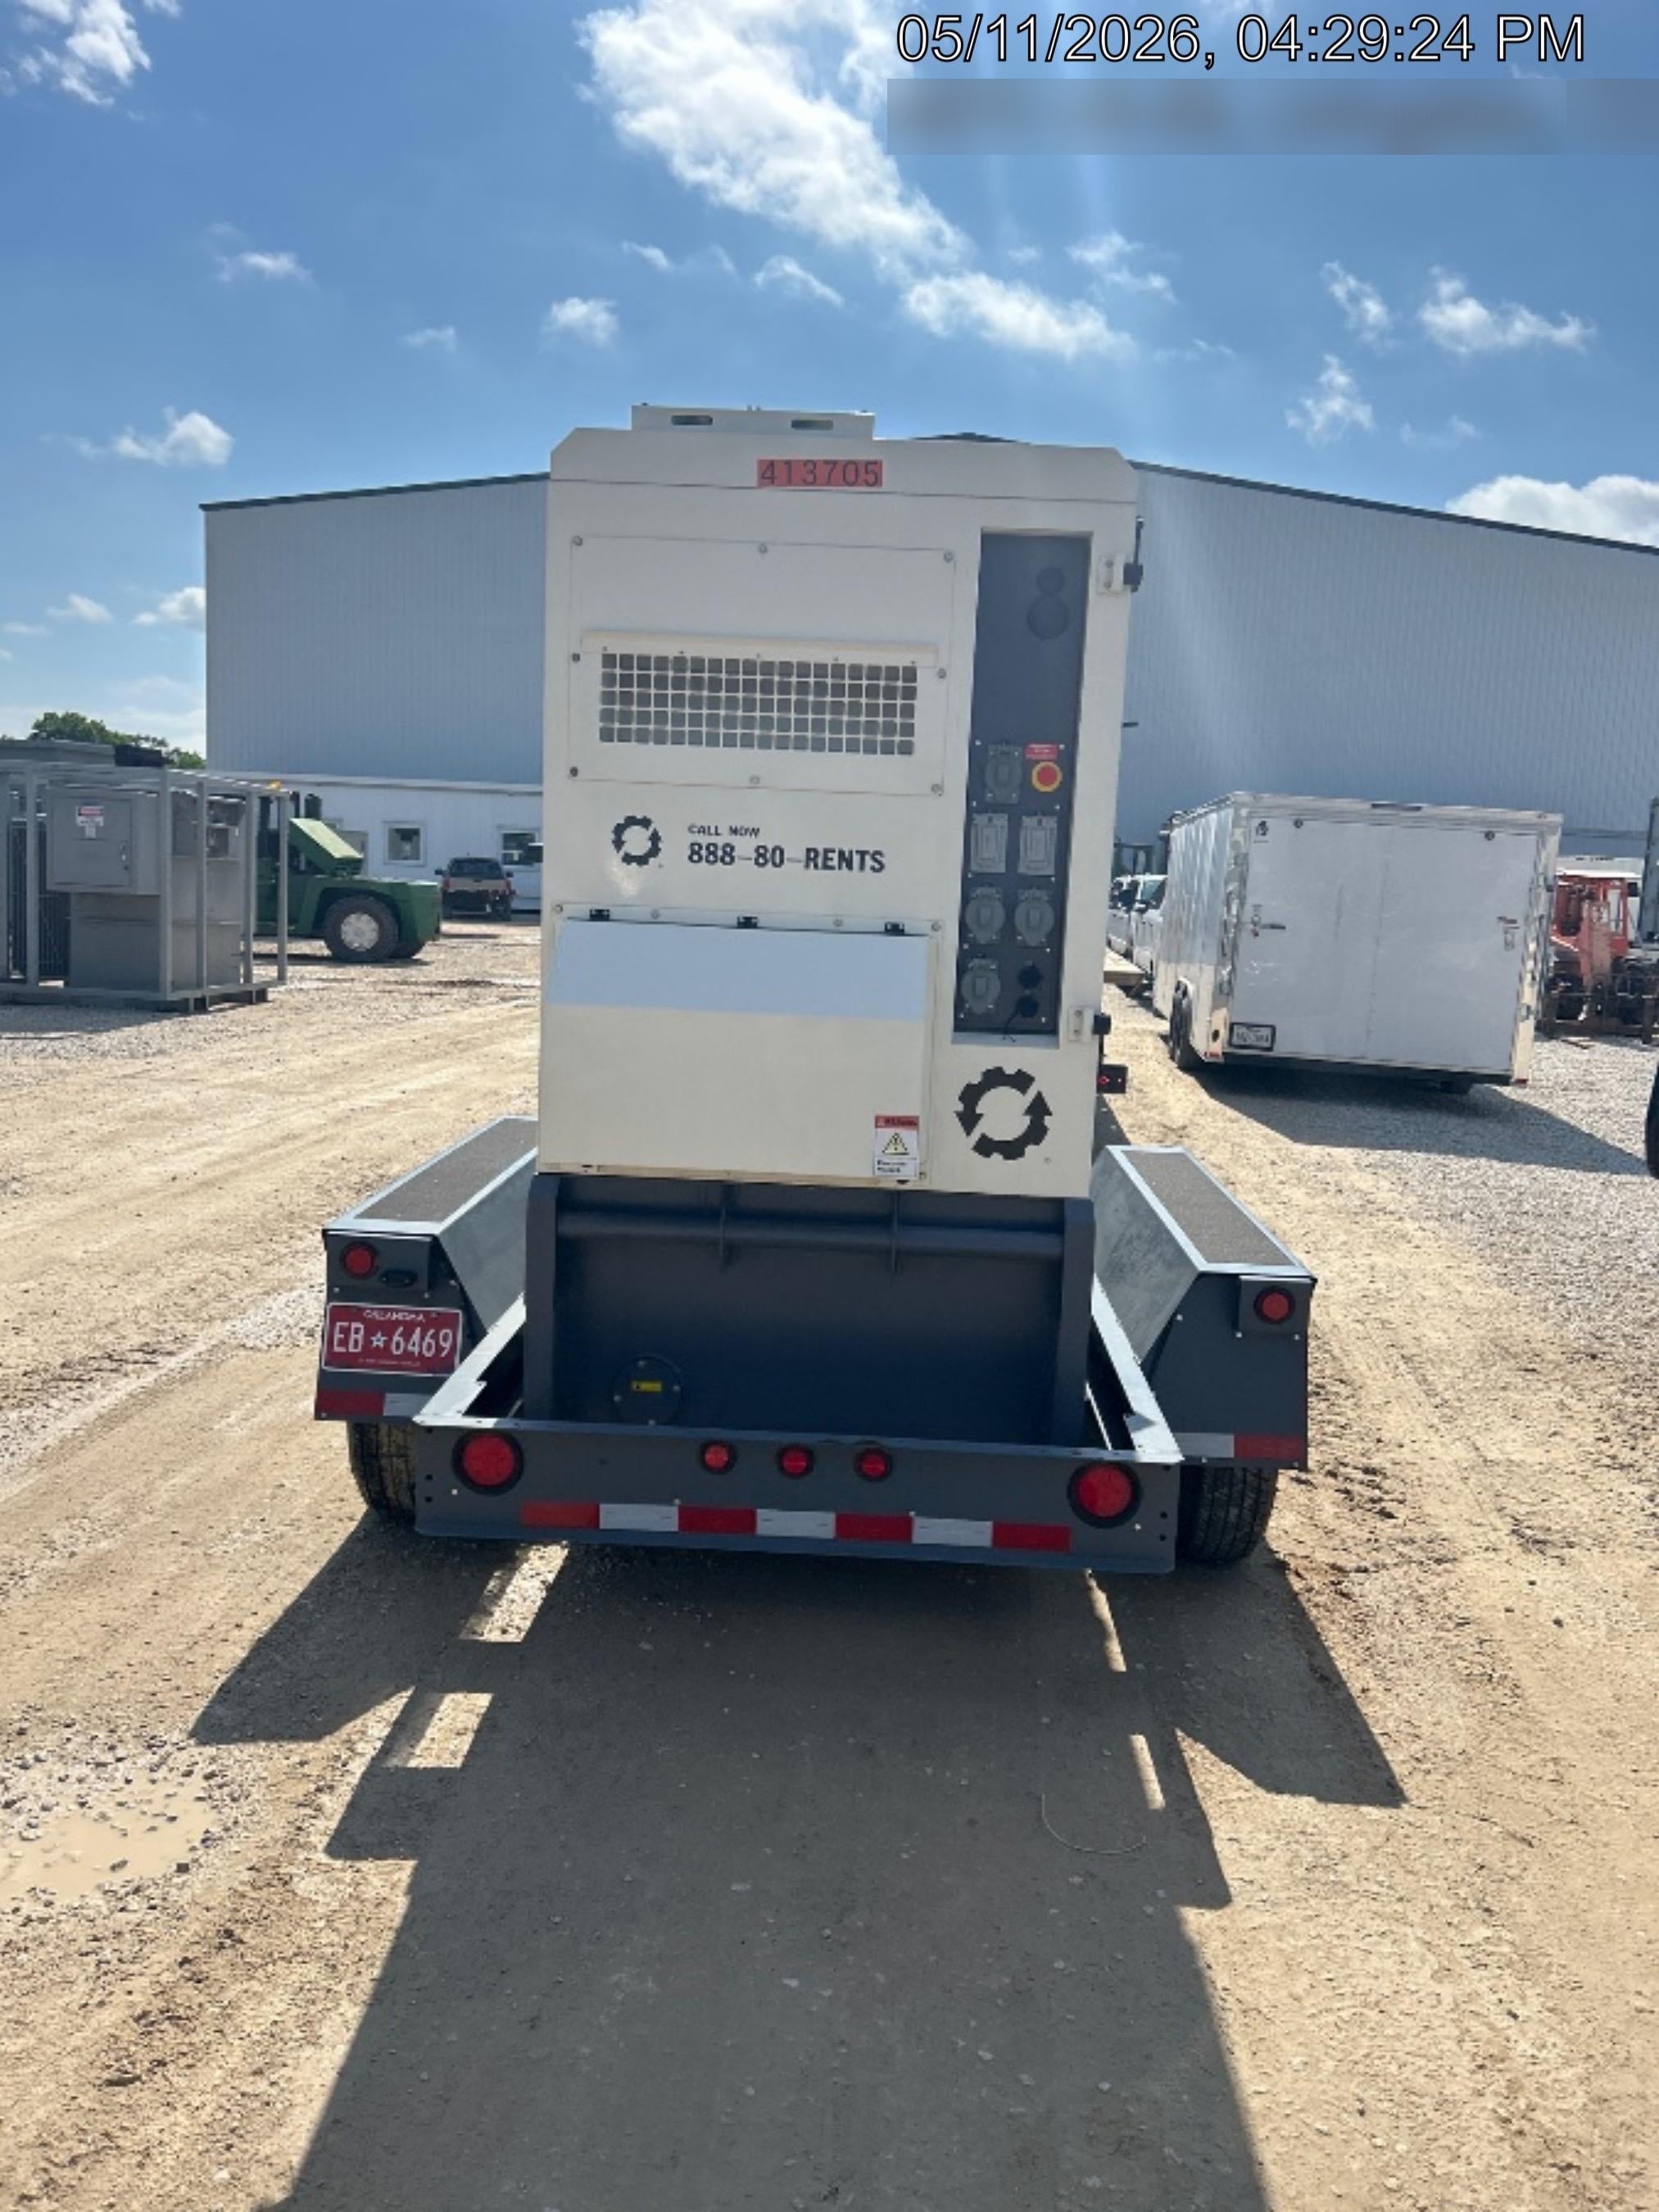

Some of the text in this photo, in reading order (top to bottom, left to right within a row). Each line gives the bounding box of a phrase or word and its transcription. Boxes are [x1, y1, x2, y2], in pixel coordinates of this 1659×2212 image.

[759, 459, 879, 487] 413705
[687, 823, 761, 838] CALL NOW
